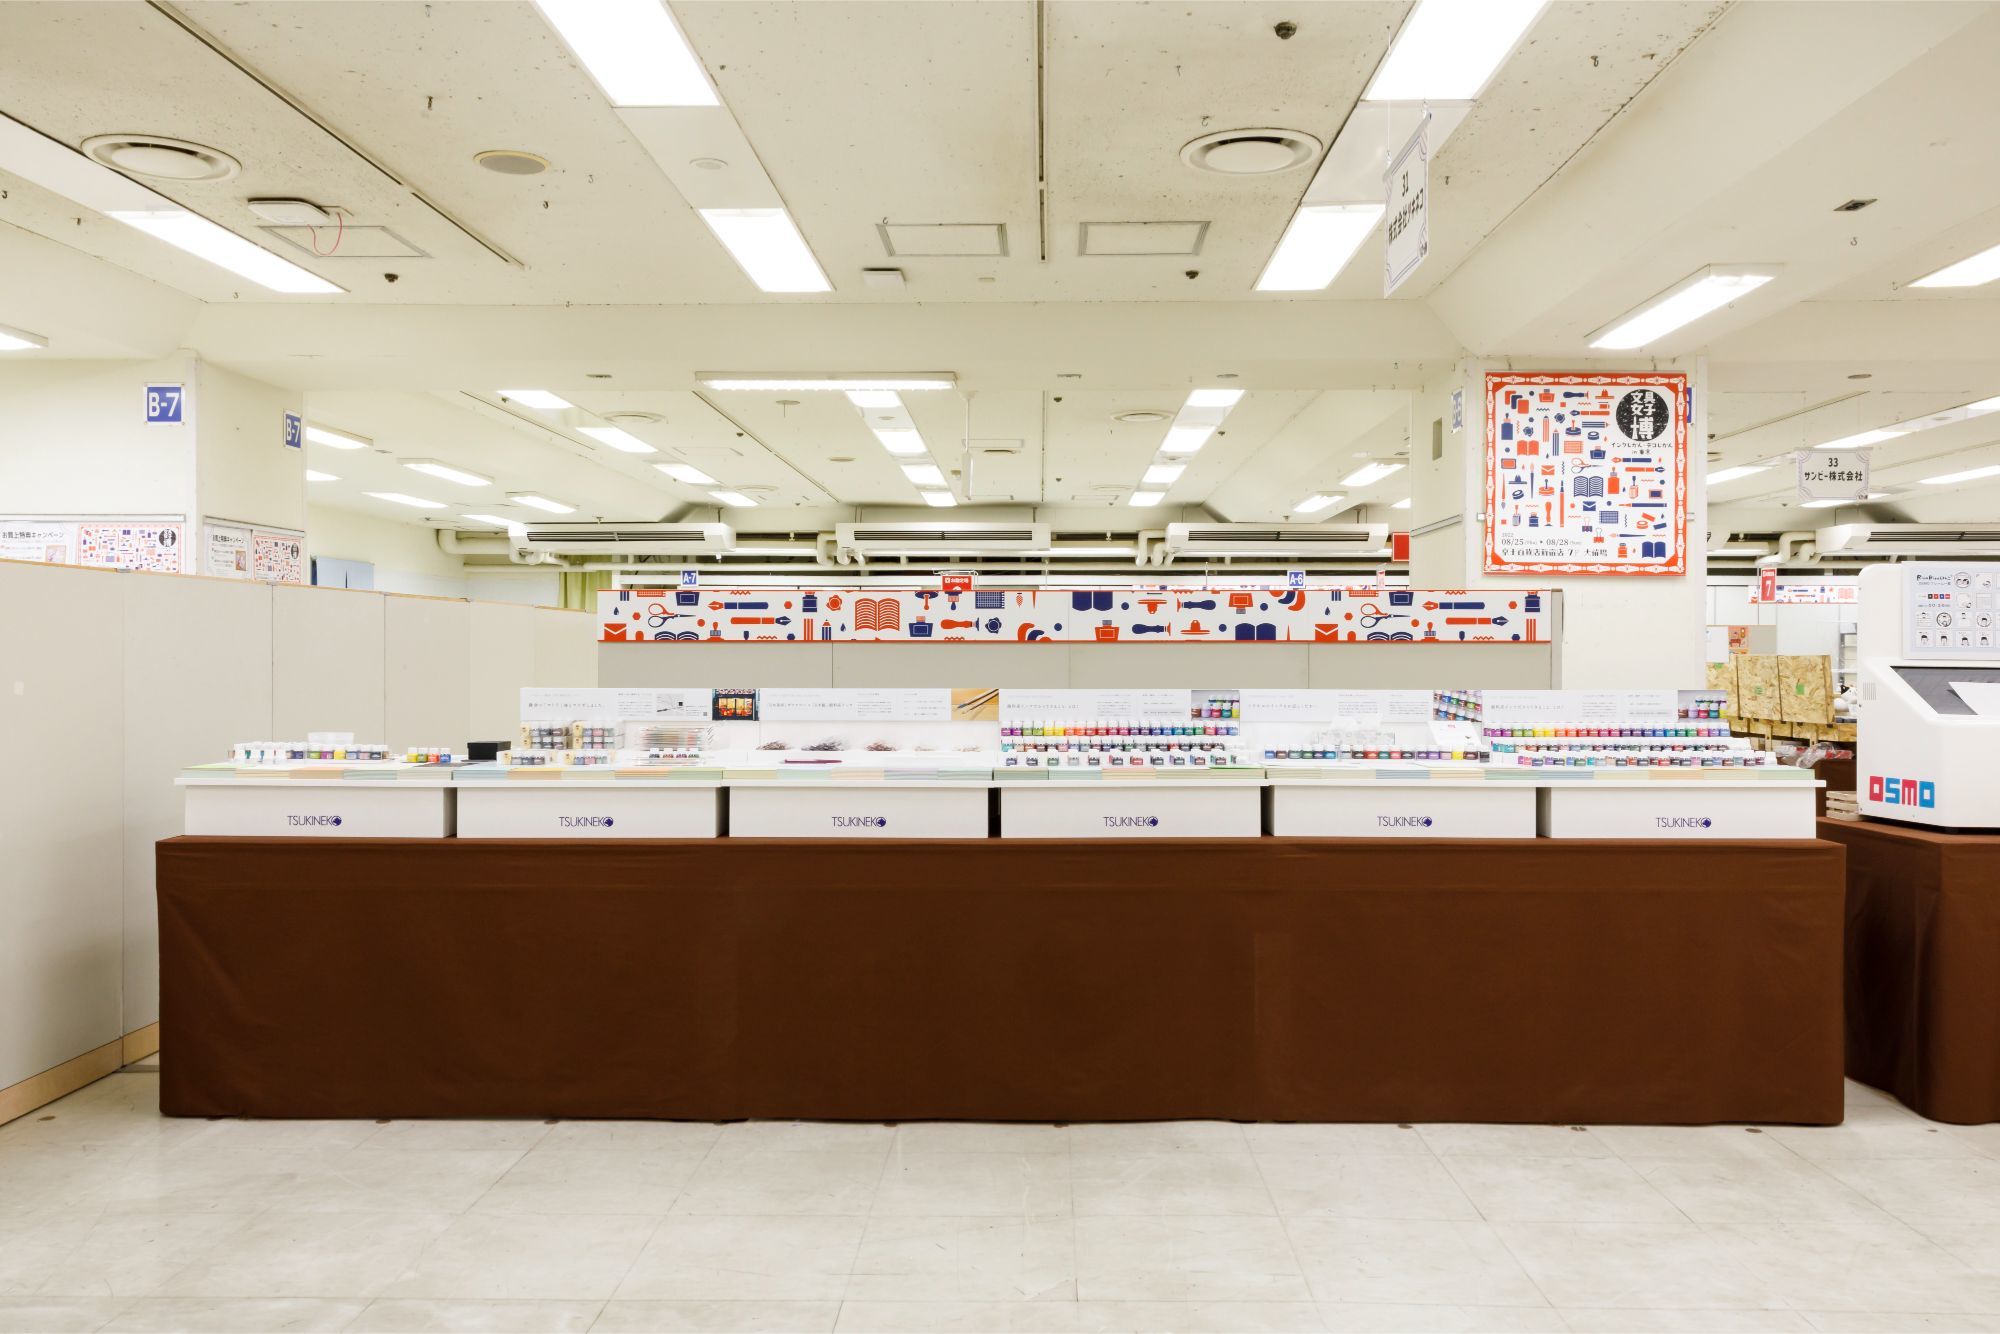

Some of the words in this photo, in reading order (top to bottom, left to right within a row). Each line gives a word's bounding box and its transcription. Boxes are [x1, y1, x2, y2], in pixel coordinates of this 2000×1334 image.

[1630, 391, 1656, 404] 文具
[148, 391, 180, 417] B-7
[1630, 404, 1656, 416] 女子
[286, 418, 301, 442] B-7
[1630, 415, 1654, 440] 博
[1828, 457, 1839, 468] 33
[1501, 538, 1524, 546] 08/25
[1546, 538, 1569, 546] 08/28
[683, 572, 696, 584] A-7
[1289, 573, 1303, 585] A-6
[1765, 579, 1772, 598] 7
[1869, 775, 1935, 809] OSMO
[288, 815, 342, 827] TSUKINEKO
[559, 816, 613, 828] TSUKINEKO
[832, 816, 886, 828] TSUKINEKO
[1104, 816, 1158, 828] TSUKINEKO
[1378, 816, 1432, 828] TSUKINEKO
[1657, 817, 1711, 829] TSUKINEKO
